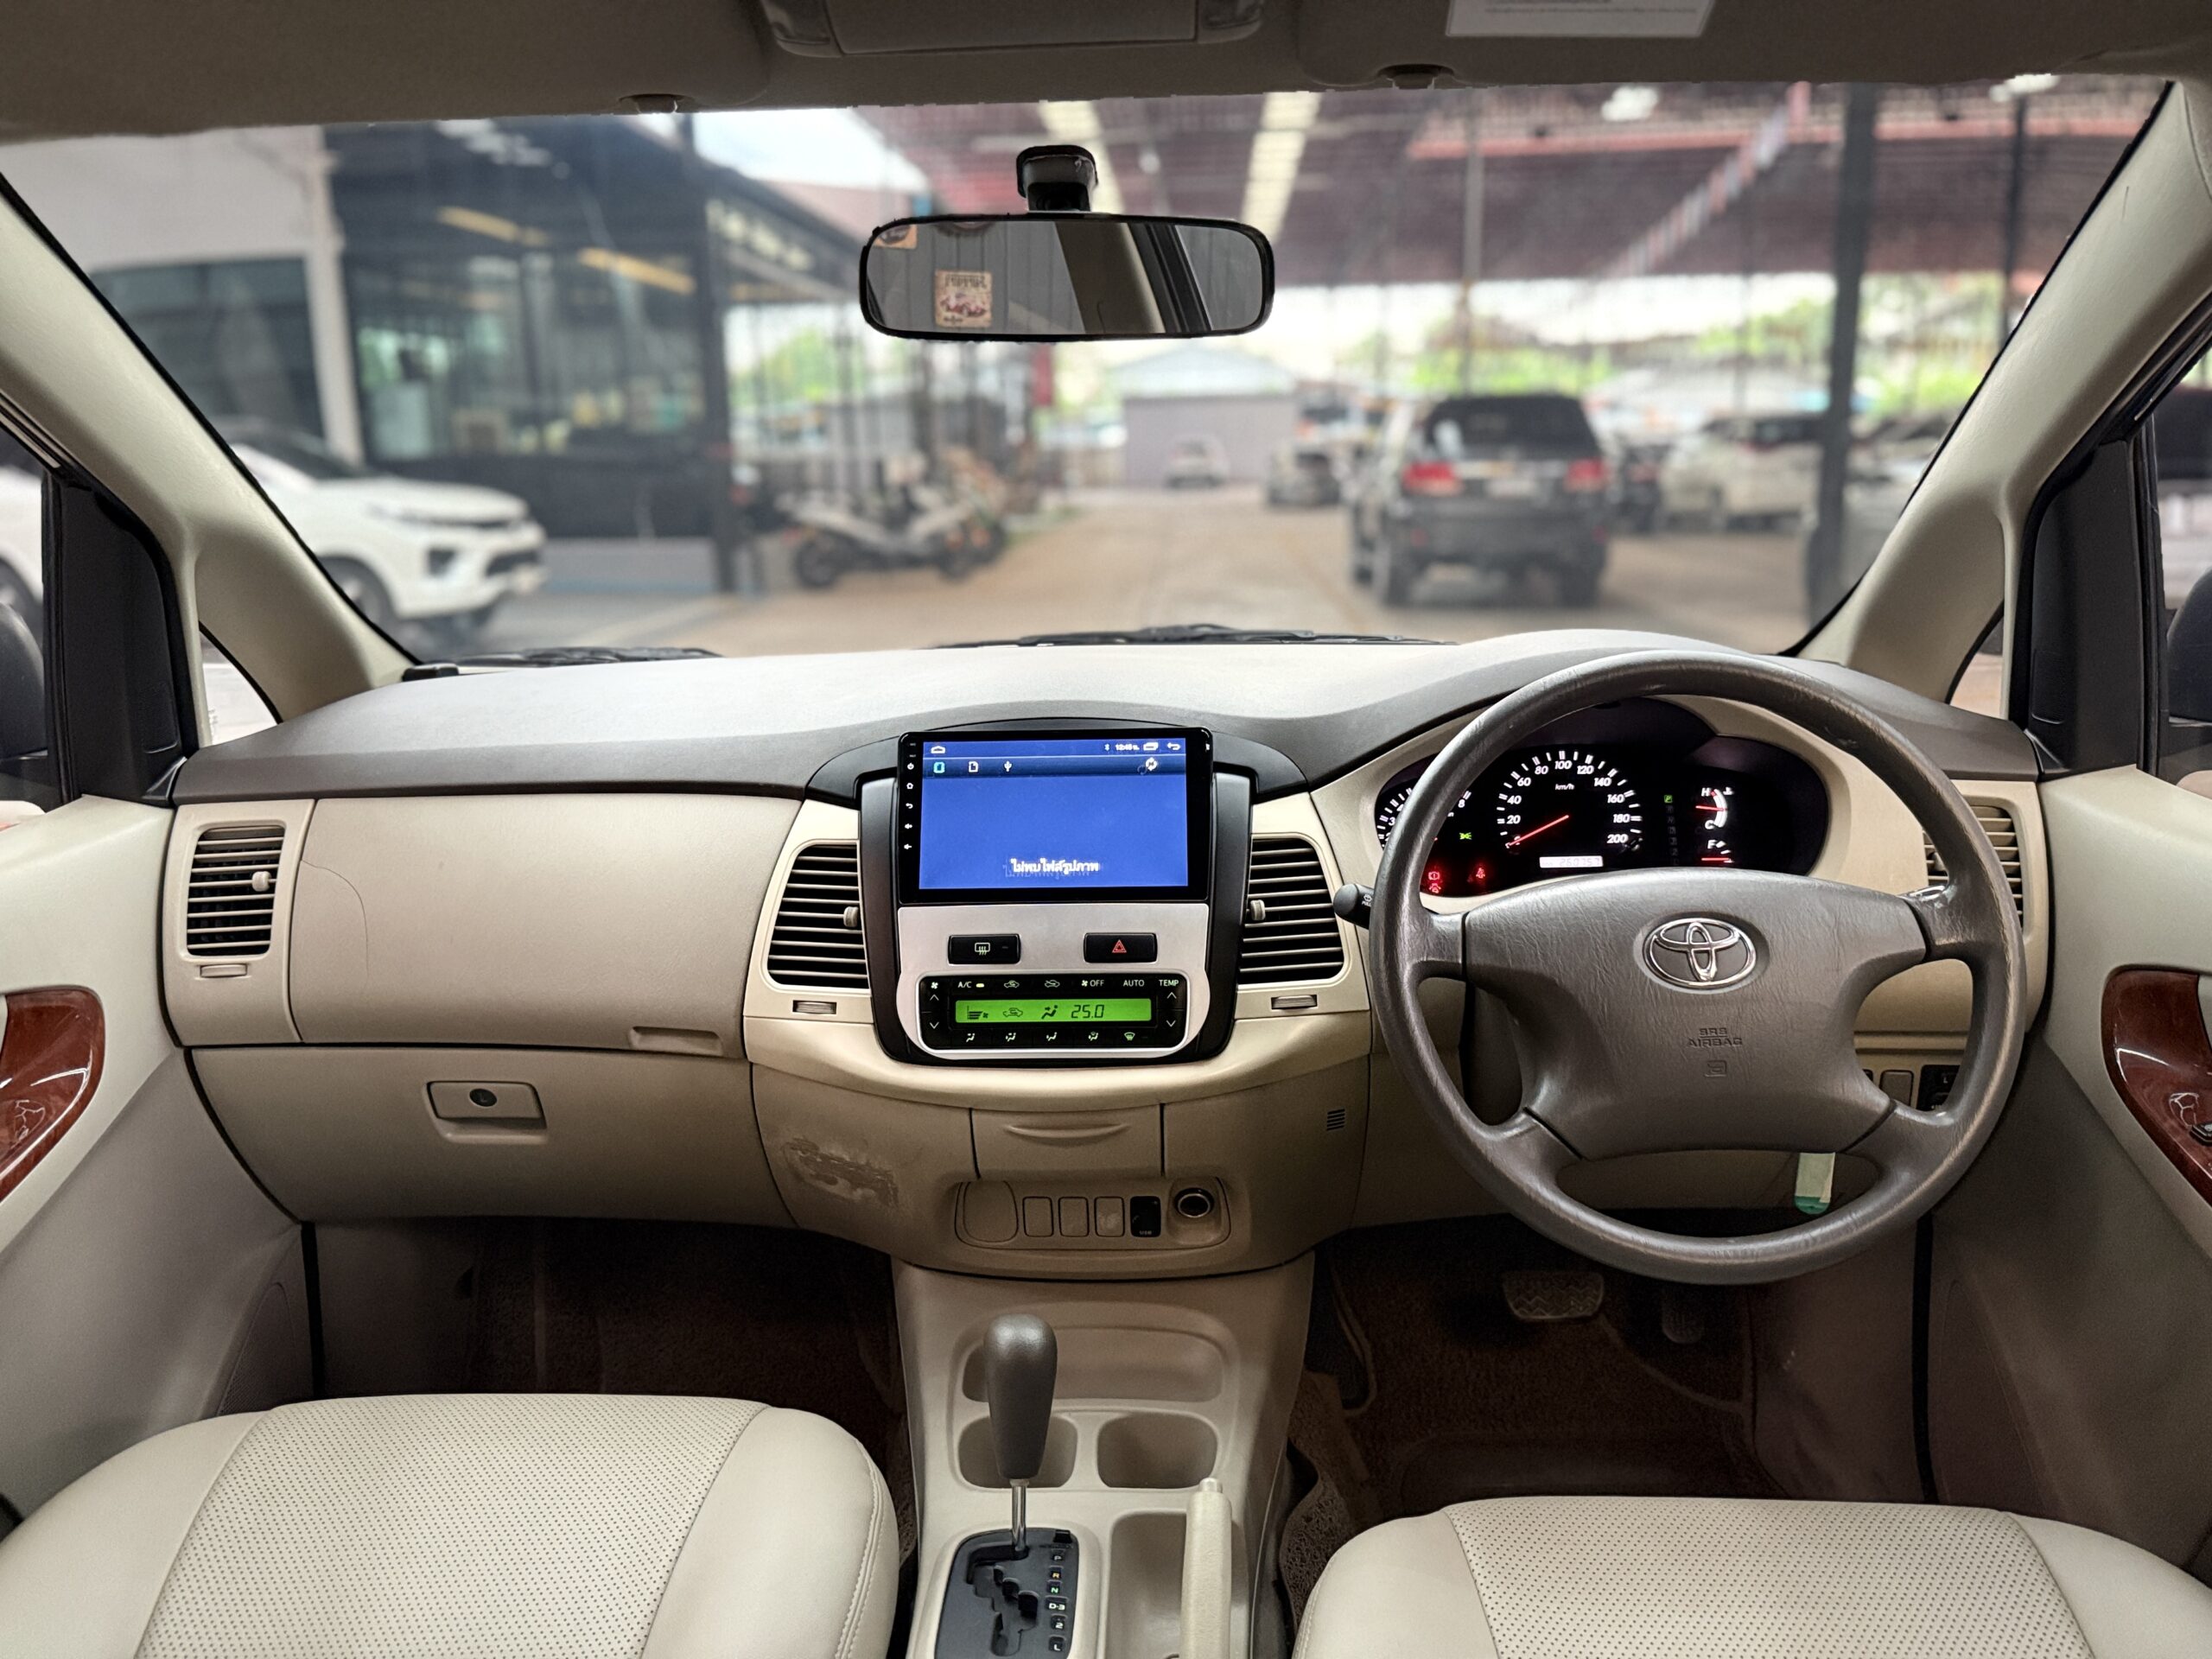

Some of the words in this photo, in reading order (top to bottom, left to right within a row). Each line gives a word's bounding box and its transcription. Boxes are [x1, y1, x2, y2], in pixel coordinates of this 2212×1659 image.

[1554, 760, 1573, 770] 100
[1535, 766, 1549, 774] 80
[1577, 766, 1594, 774] 120
[1517, 778, 1531, 786] 60
[1594, 778, 1612, 786] 140
[1700, 787, 1711, 797] H
[1458, 798, 1465, 808] 8
[1507, 796, 1522, 804] 40
[1607, 794, 1624, 804] 160
[1388, 817, 1395, 826] 3
[1506, 815, 1521, 824] 20
[1612, 814, 1630, 823] 180
[1705, 819, 1714, 830] C
[1606, 834, 1629, 843] 200
[1707, 839, 1717, 849] F
[1071, 1004, 1105, 1019] 25.0
[1700, 1027, 1728, 1036] SRS
[1688, 1037, 1743, 1047] AIRBAG
